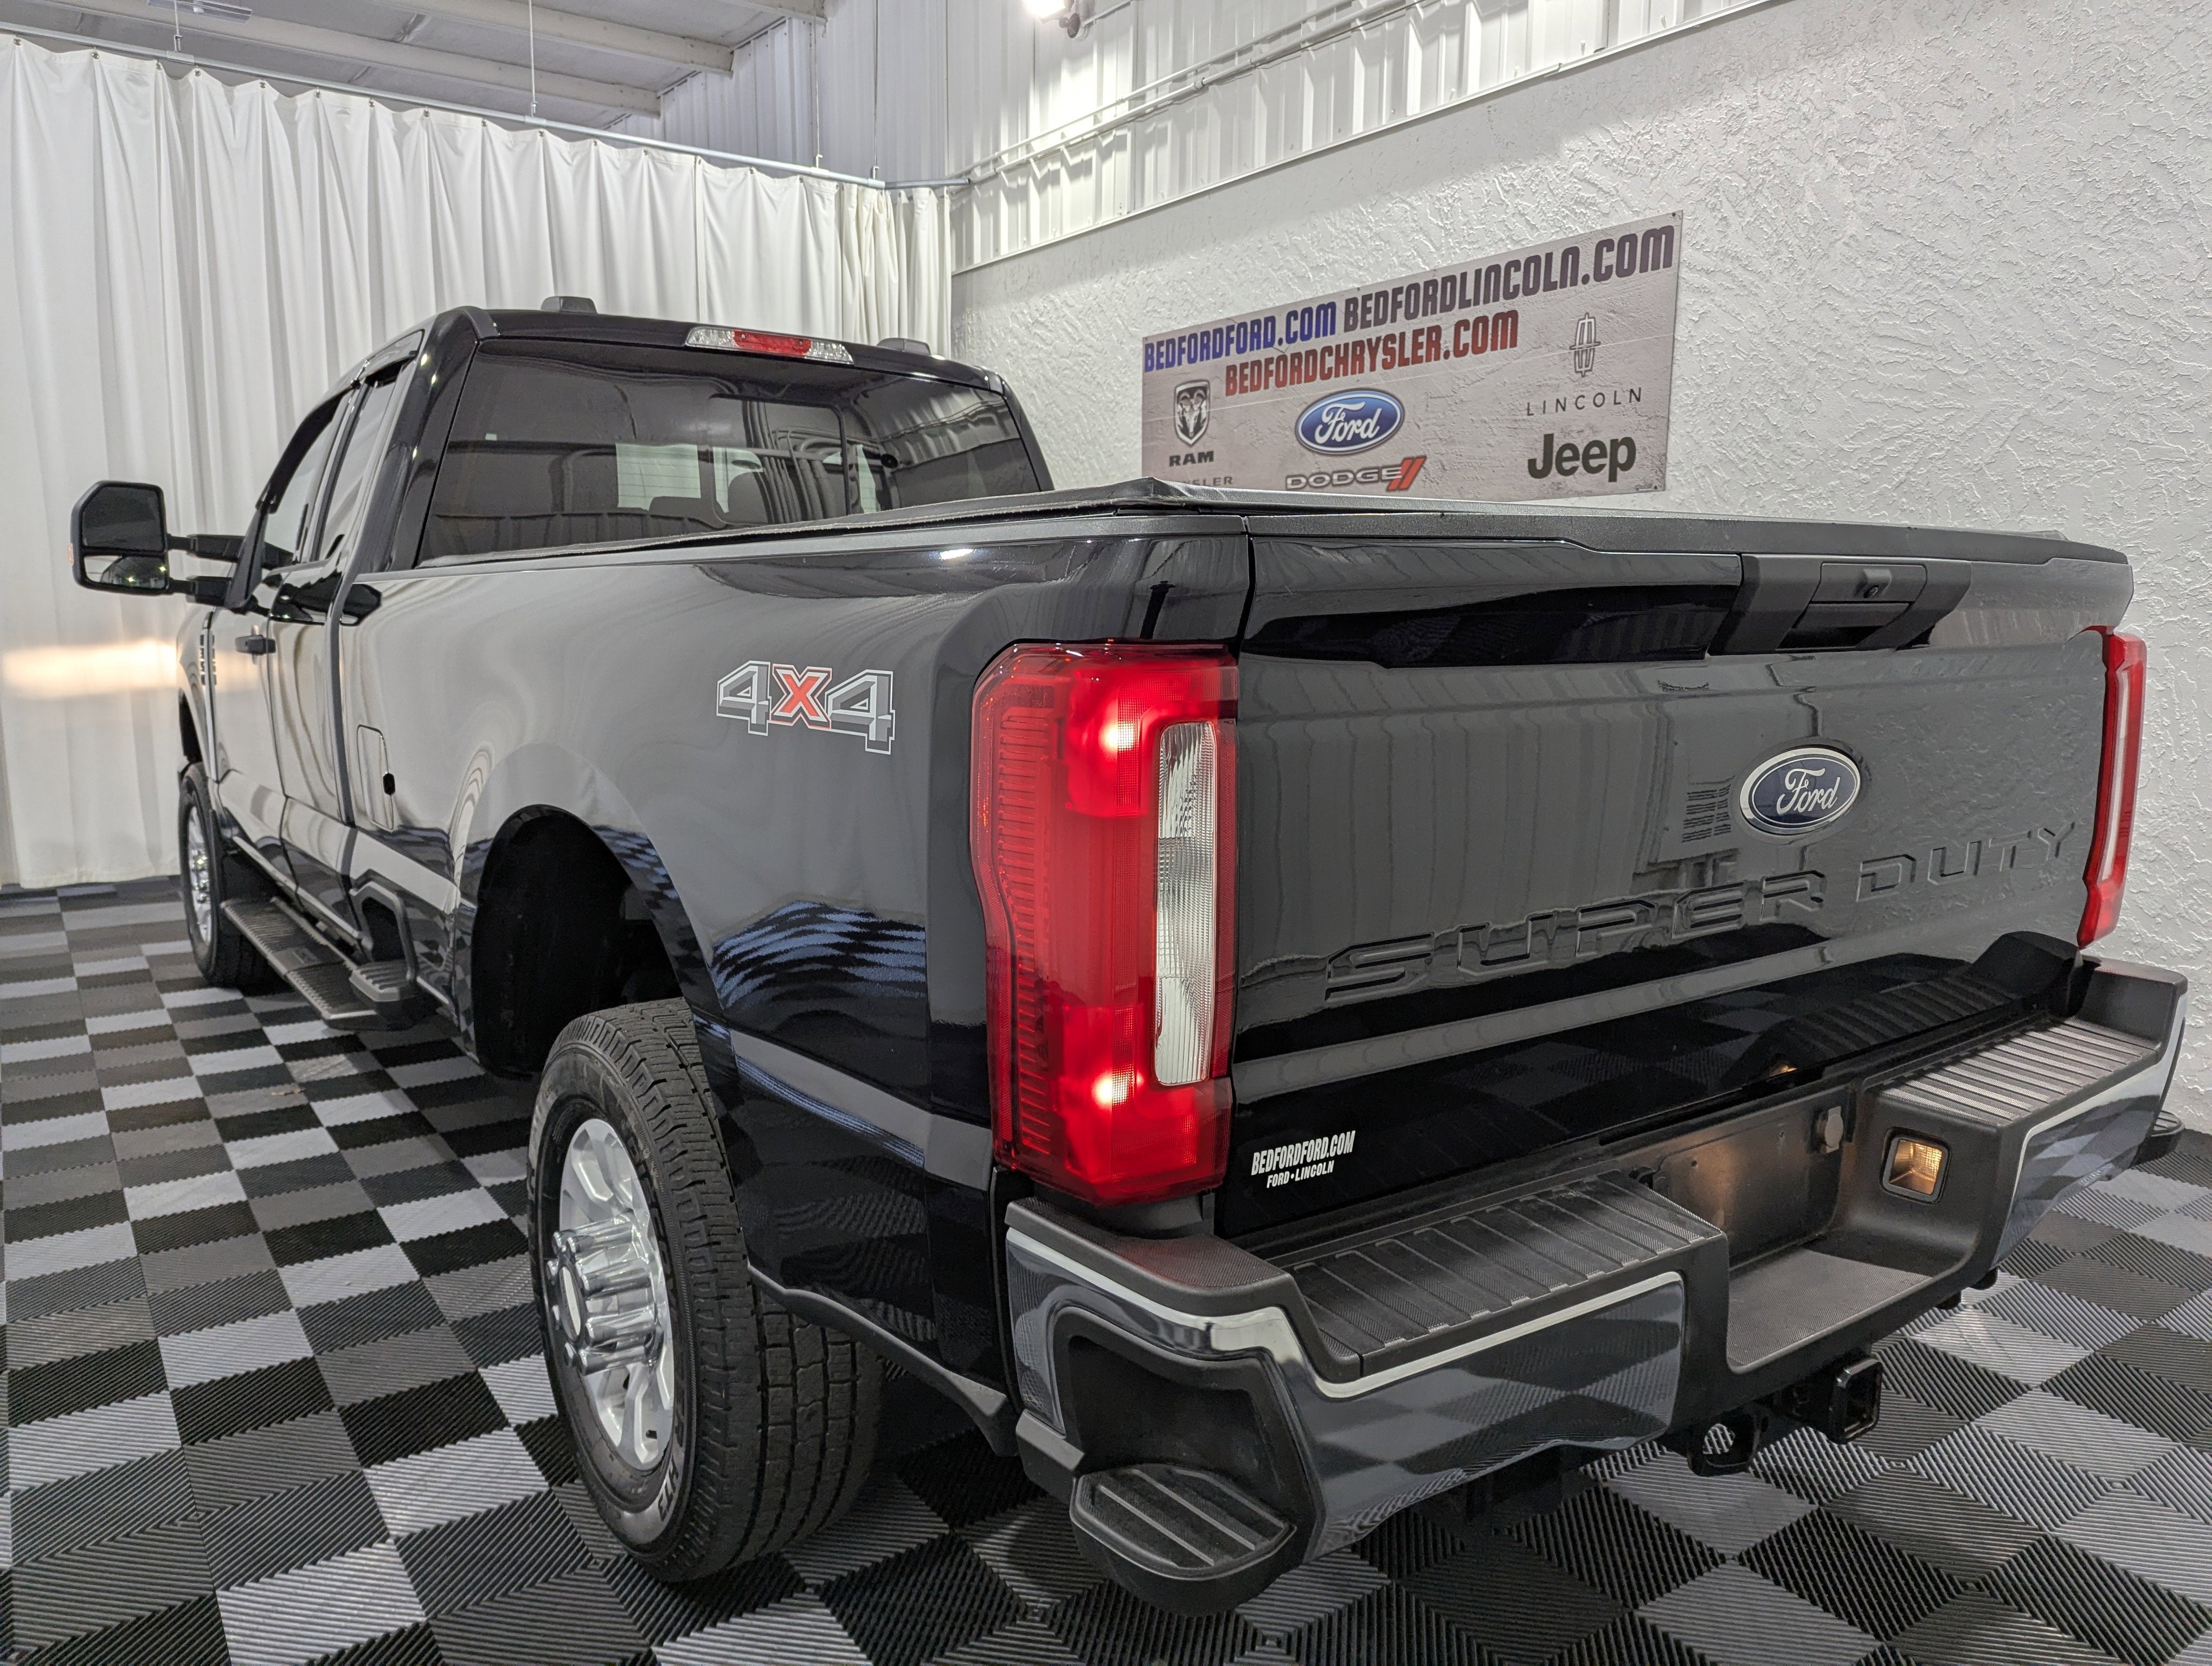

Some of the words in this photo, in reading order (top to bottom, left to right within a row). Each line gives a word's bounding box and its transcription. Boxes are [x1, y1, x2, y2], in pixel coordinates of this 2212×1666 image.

[1144, 302, 1337, 373] BEDFORDFORD.COM
[1343, 225, 1675, 332] BEDFORDLINCOLN.COM
[1225, 310, 1518, 396] BEDFORDCHRYSLER.COM
[1315, 401, 1382, 444] Ford
[1527, 387, 1642, 416] LINCOLN
[1169, 451, 1214, 467] RAM
[1286, 463, 1403, 489] DODGE
[1528, 433, 1636, 482] Jeep
[1777, 768, 1841, 815] Ford
[1324, 869, 1827, 1002] SUPER
[1855, 822, 2075, 902] DUTY
[1251, 1130, 1355, 1175] BEDFORDFORD.COM
